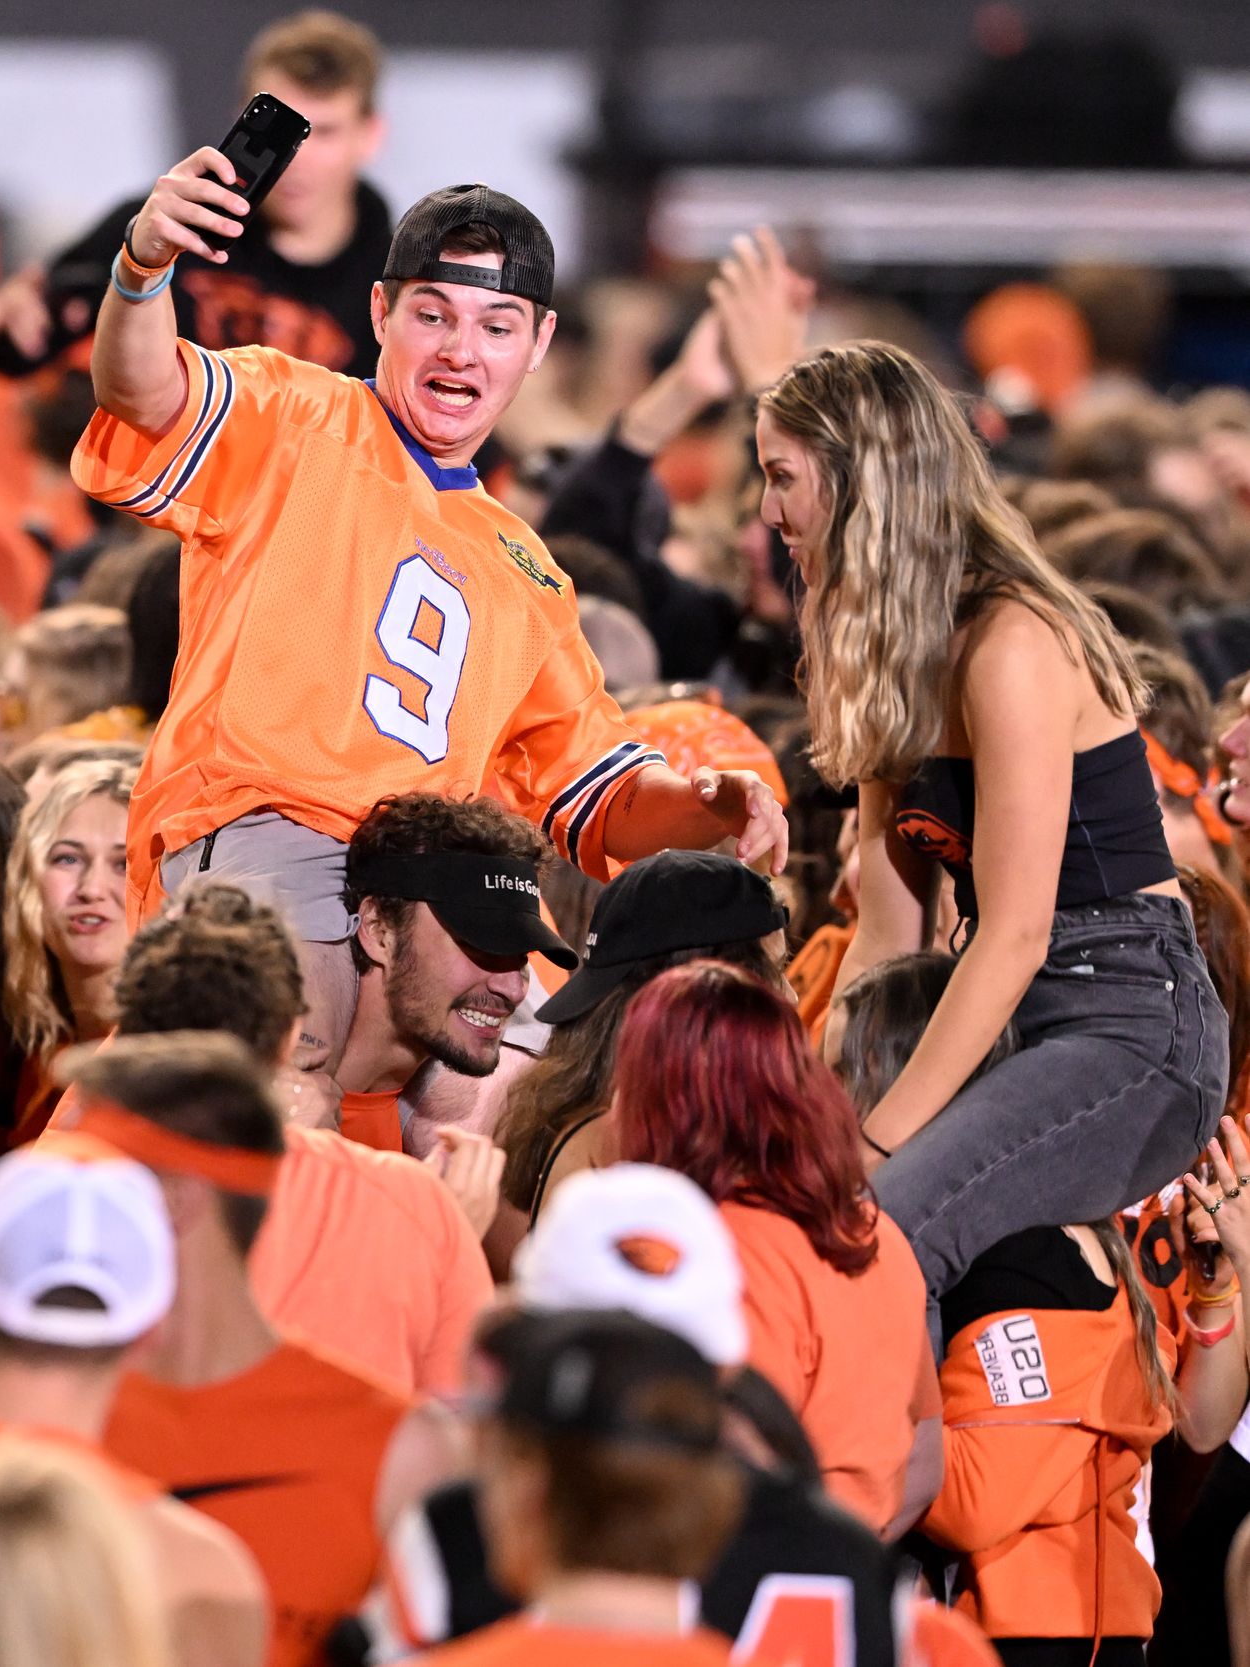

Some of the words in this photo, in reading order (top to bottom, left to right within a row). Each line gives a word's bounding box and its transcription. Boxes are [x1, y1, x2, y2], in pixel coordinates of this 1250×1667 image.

[363, 552, 472, 766] 9
[484, 874, 514, 890] Life
[515, 876, 525, 892] is
